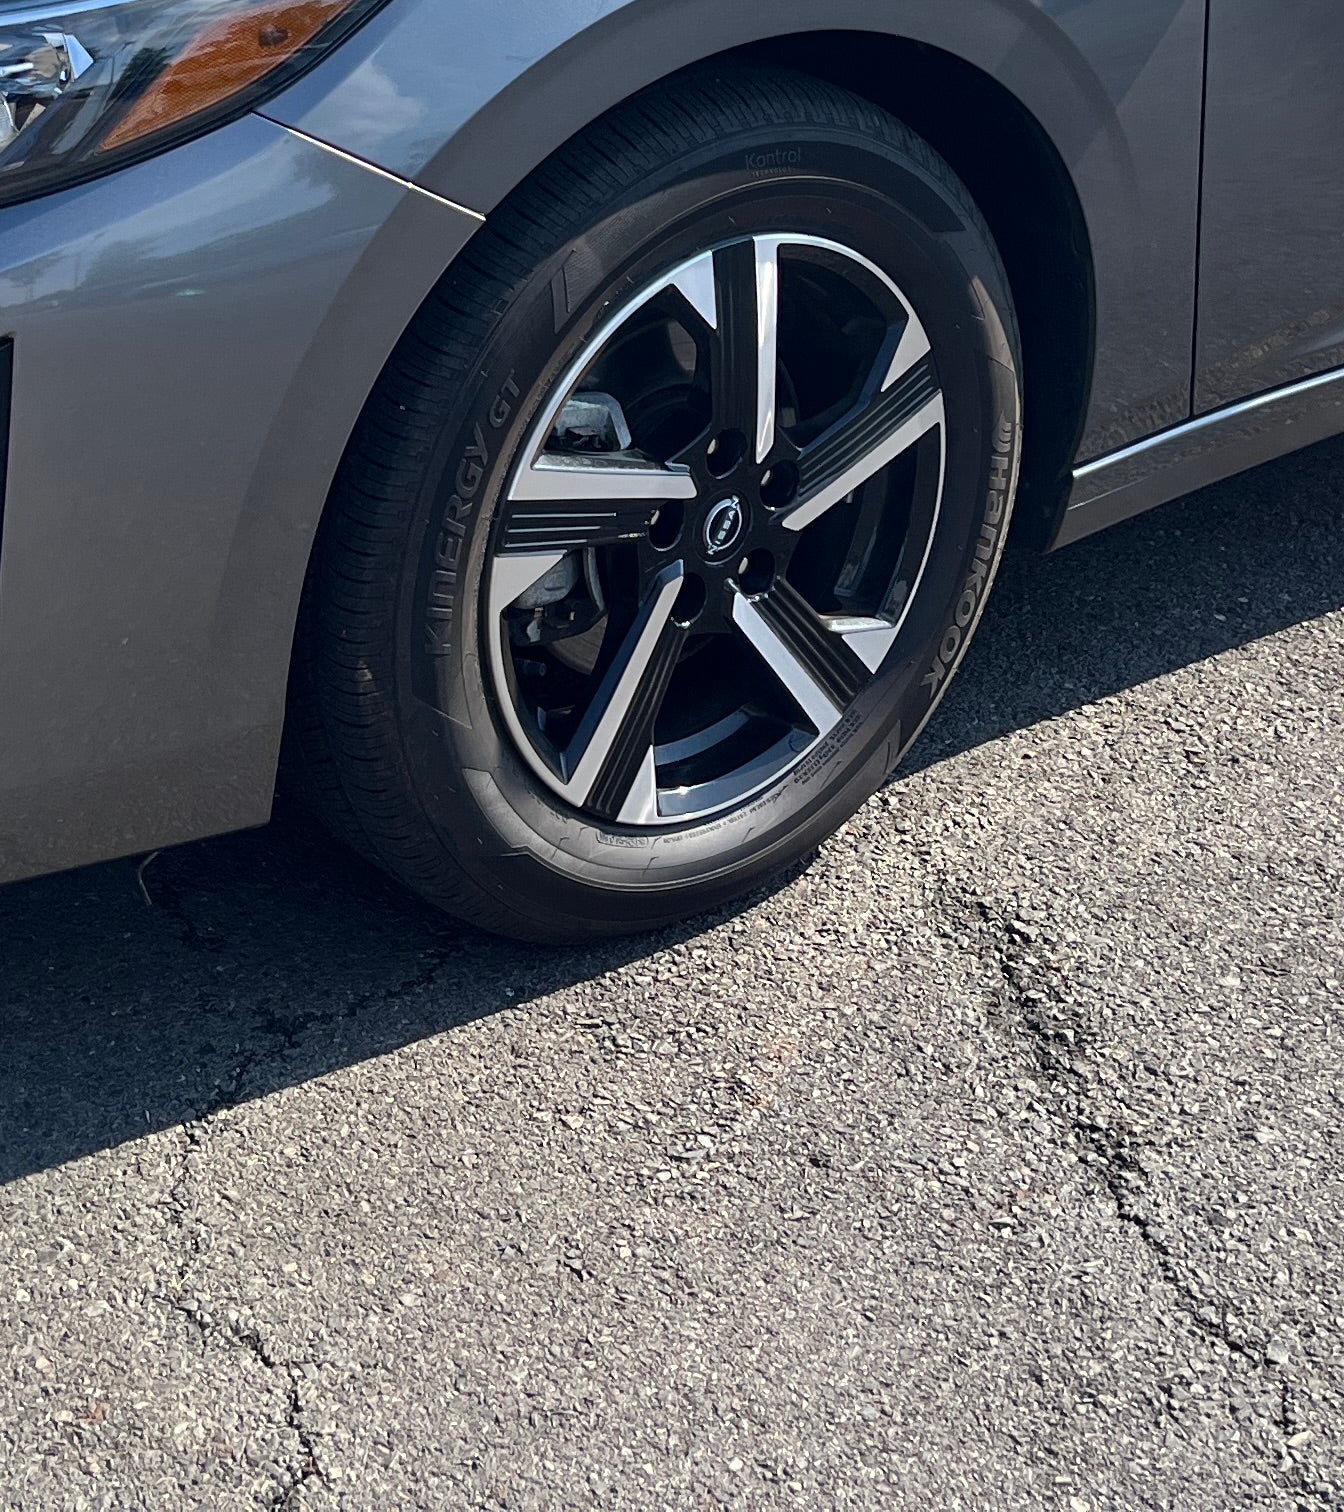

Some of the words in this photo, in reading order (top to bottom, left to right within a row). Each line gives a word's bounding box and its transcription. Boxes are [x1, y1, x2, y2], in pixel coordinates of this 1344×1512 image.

[744, 146, 801, 171] Kontrol
[424, 422, 488, 656] KINERGY
[488, 368, 521, 429] GT
